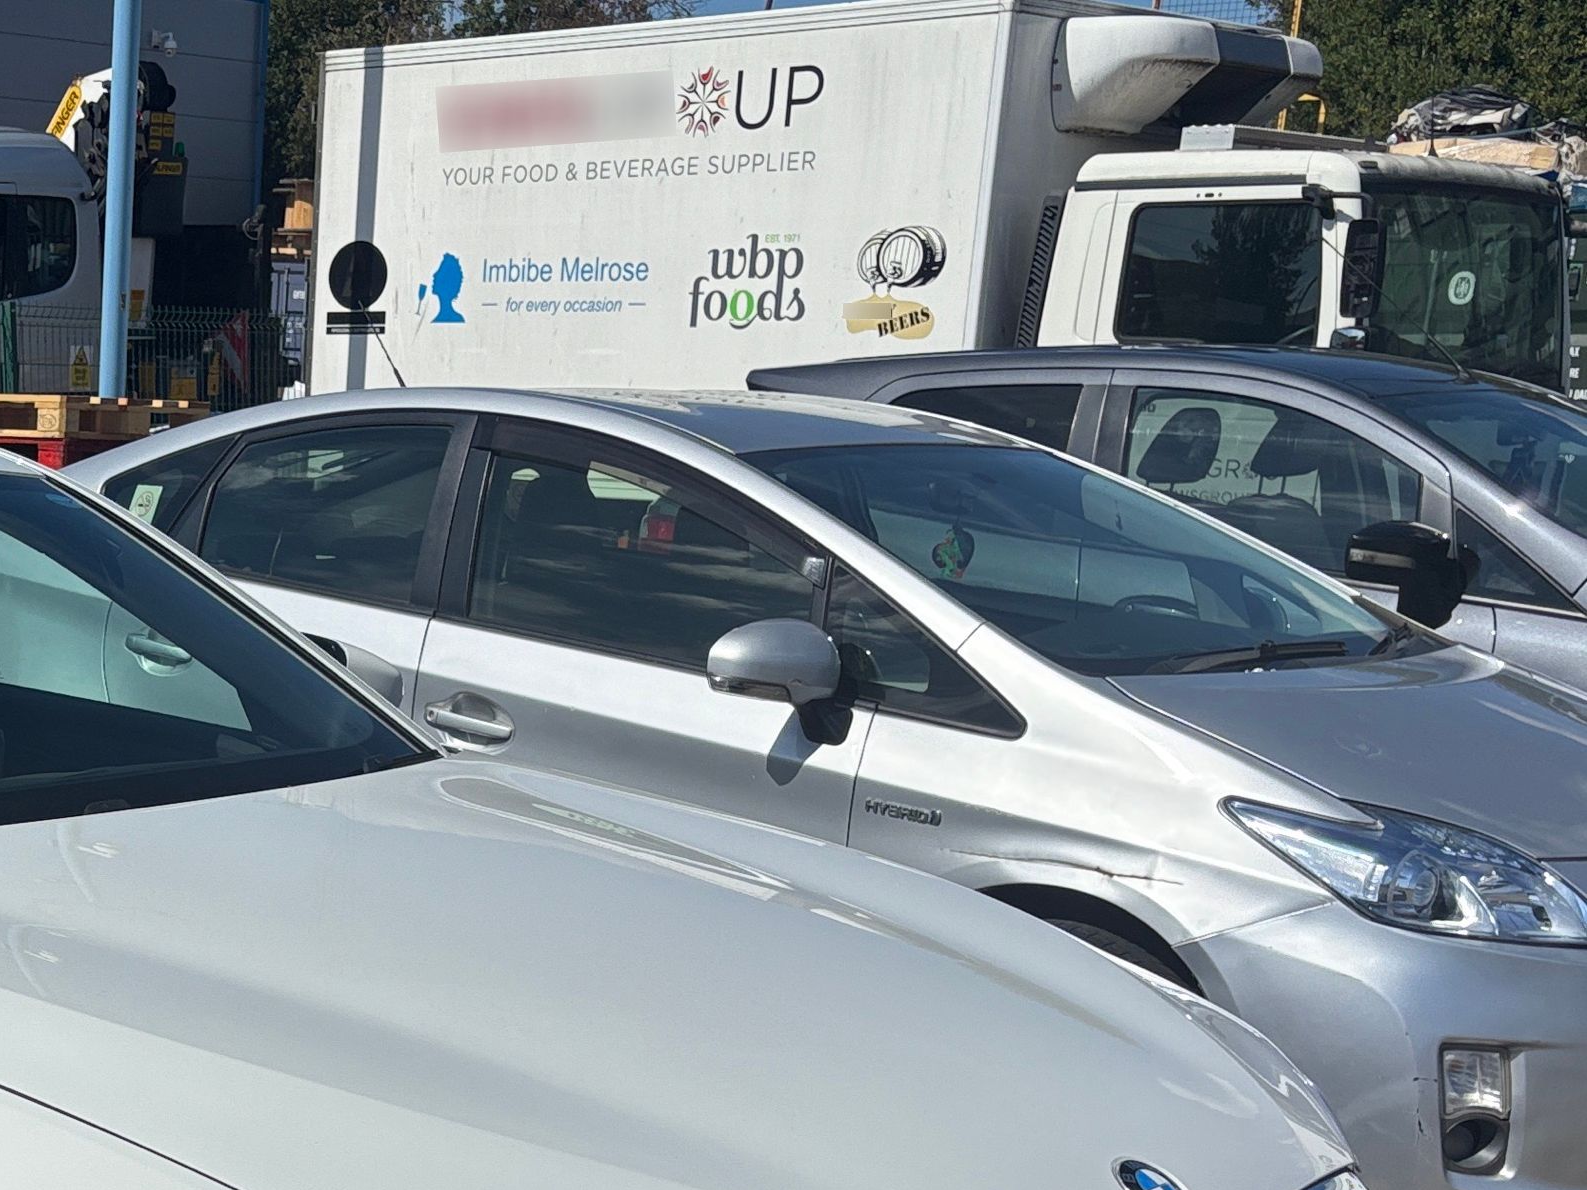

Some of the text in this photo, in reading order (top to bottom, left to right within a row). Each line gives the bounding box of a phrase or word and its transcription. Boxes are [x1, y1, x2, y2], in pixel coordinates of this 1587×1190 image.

[442, 151, 816, 187] YOUR FOOD & BEVERAGE SUPPLIER
[783, 234, 801, 243] 1971
[482, 257, 649, 283] Imbibe Melrose
[707, 233, 804, 280] wbp
[505, 297, 622, 316] for every occasion
[688, 276, 806, 330] foods
[877, 306, 931, 338] BEERS
[864, 799, 930, 825] HYBRID
